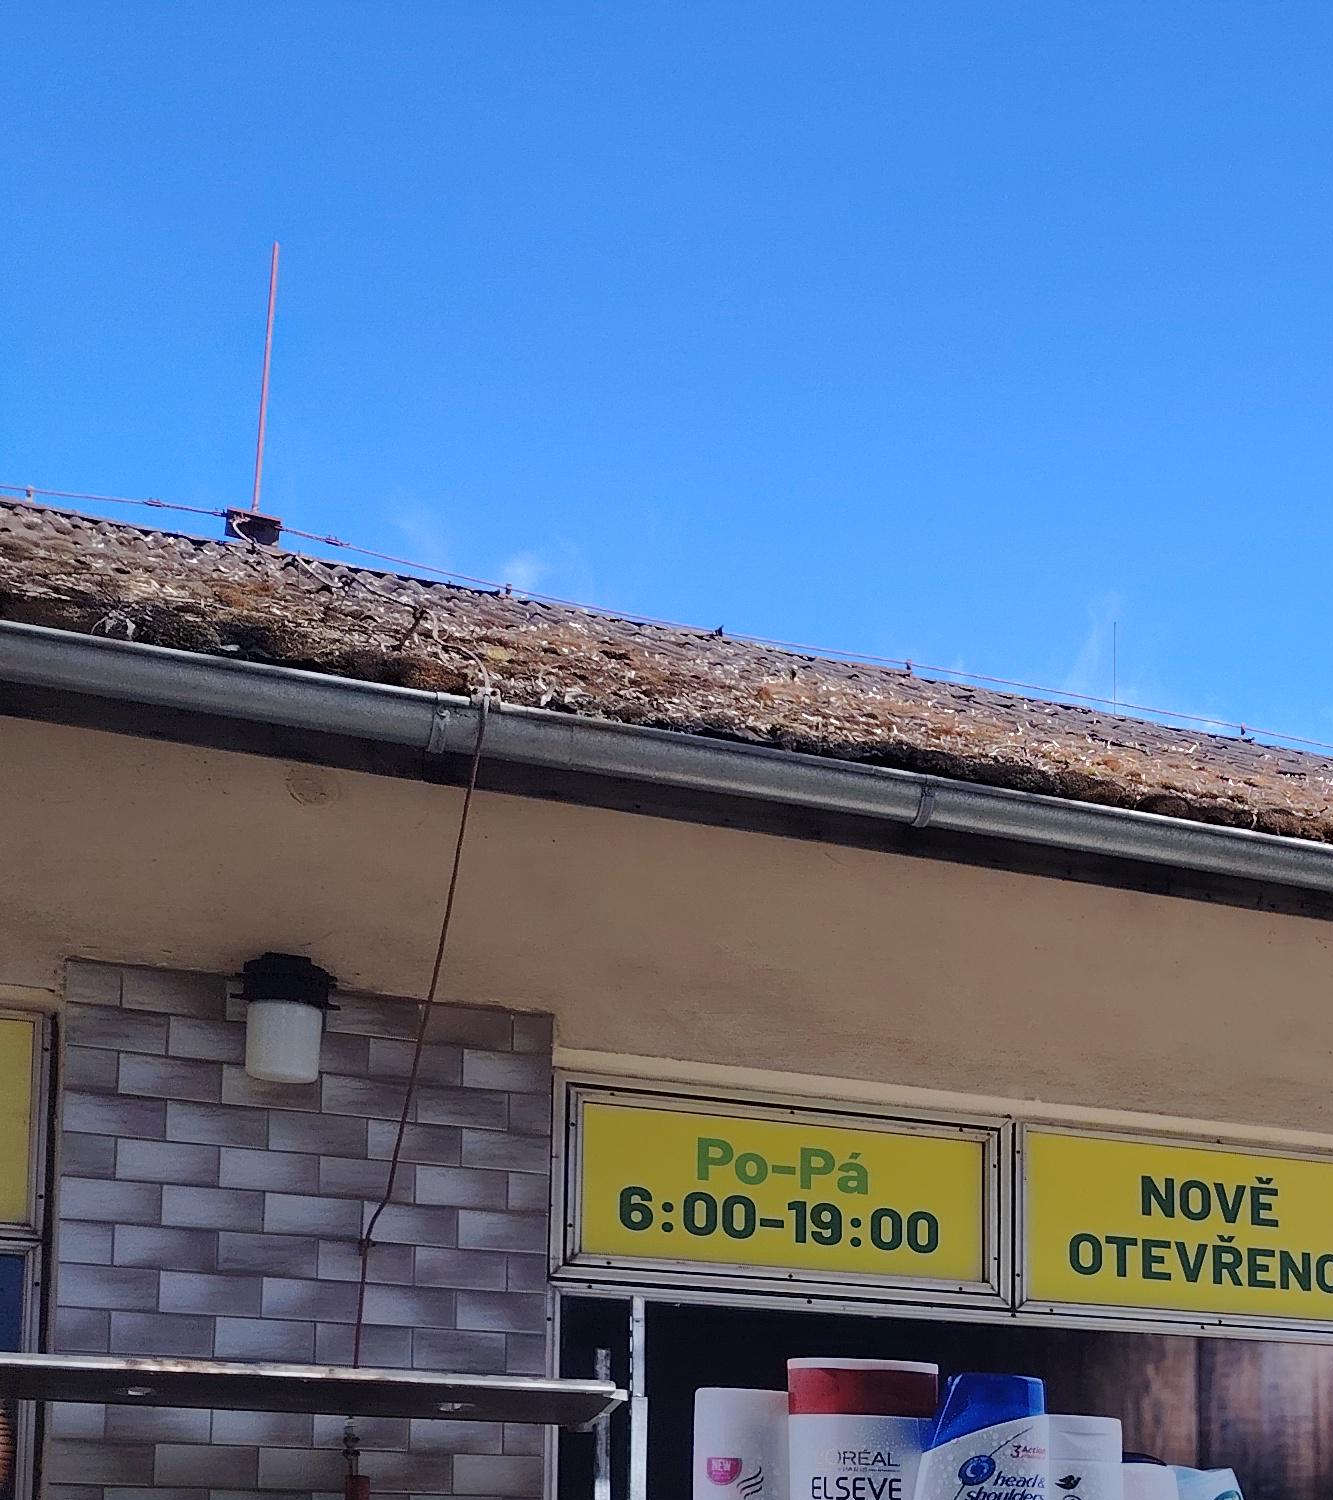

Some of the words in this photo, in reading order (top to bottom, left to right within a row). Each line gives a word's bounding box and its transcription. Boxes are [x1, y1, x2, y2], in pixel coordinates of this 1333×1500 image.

[698, 1137, 871, 1195] Po-Pá
[617, 1186, 940, 1255] 6:00-19:00
[1139, 1174, 1281, 1228] NOVĚ
[1010, 1444, 1021, 1459] 3
[993, 1471, 1039, 1488] head
[1038, 1478, 1046, 1489] &
